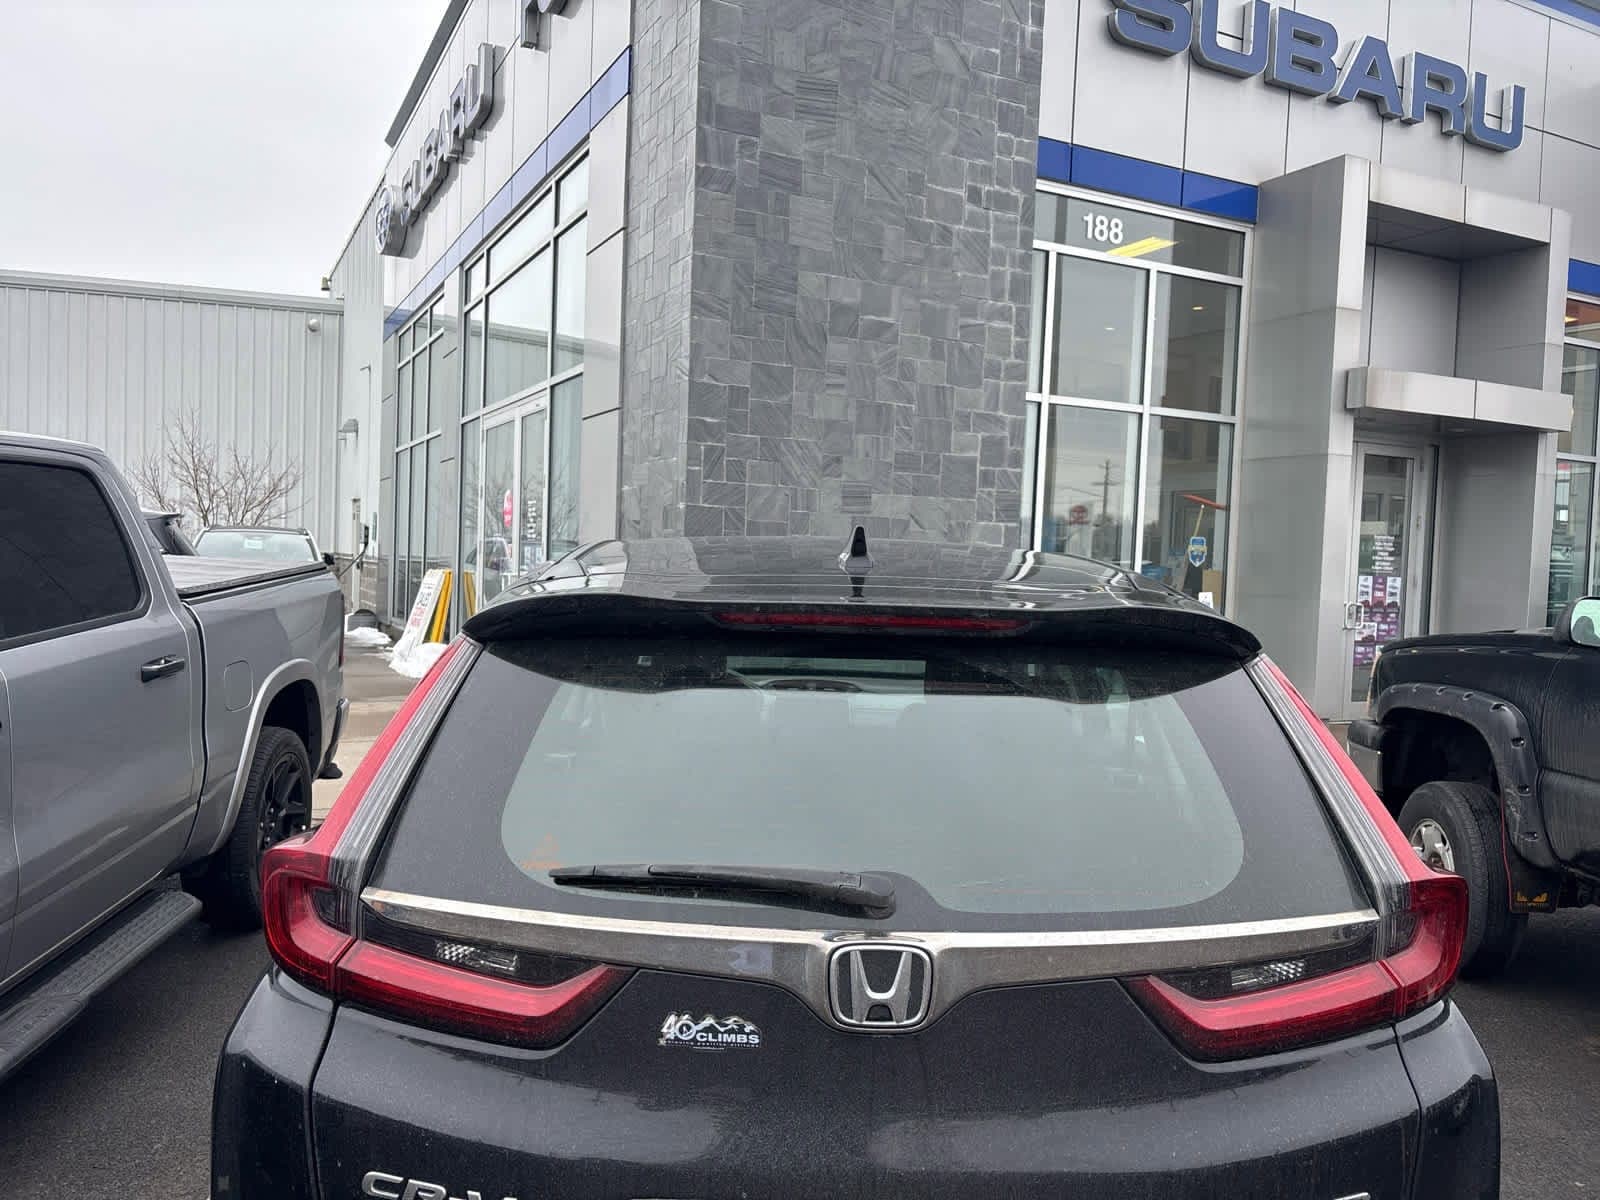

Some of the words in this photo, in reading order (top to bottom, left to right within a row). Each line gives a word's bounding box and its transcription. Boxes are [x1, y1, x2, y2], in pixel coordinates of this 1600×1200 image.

[1108, 0, 1526, 153] SUBARU
[401, 43, 495, 226] SUBARU
[1083, 212, 1123, 245] 188
[695, 1032, 760, 1045] CLIMBS
[361, 1170, 518, 1200] CR
